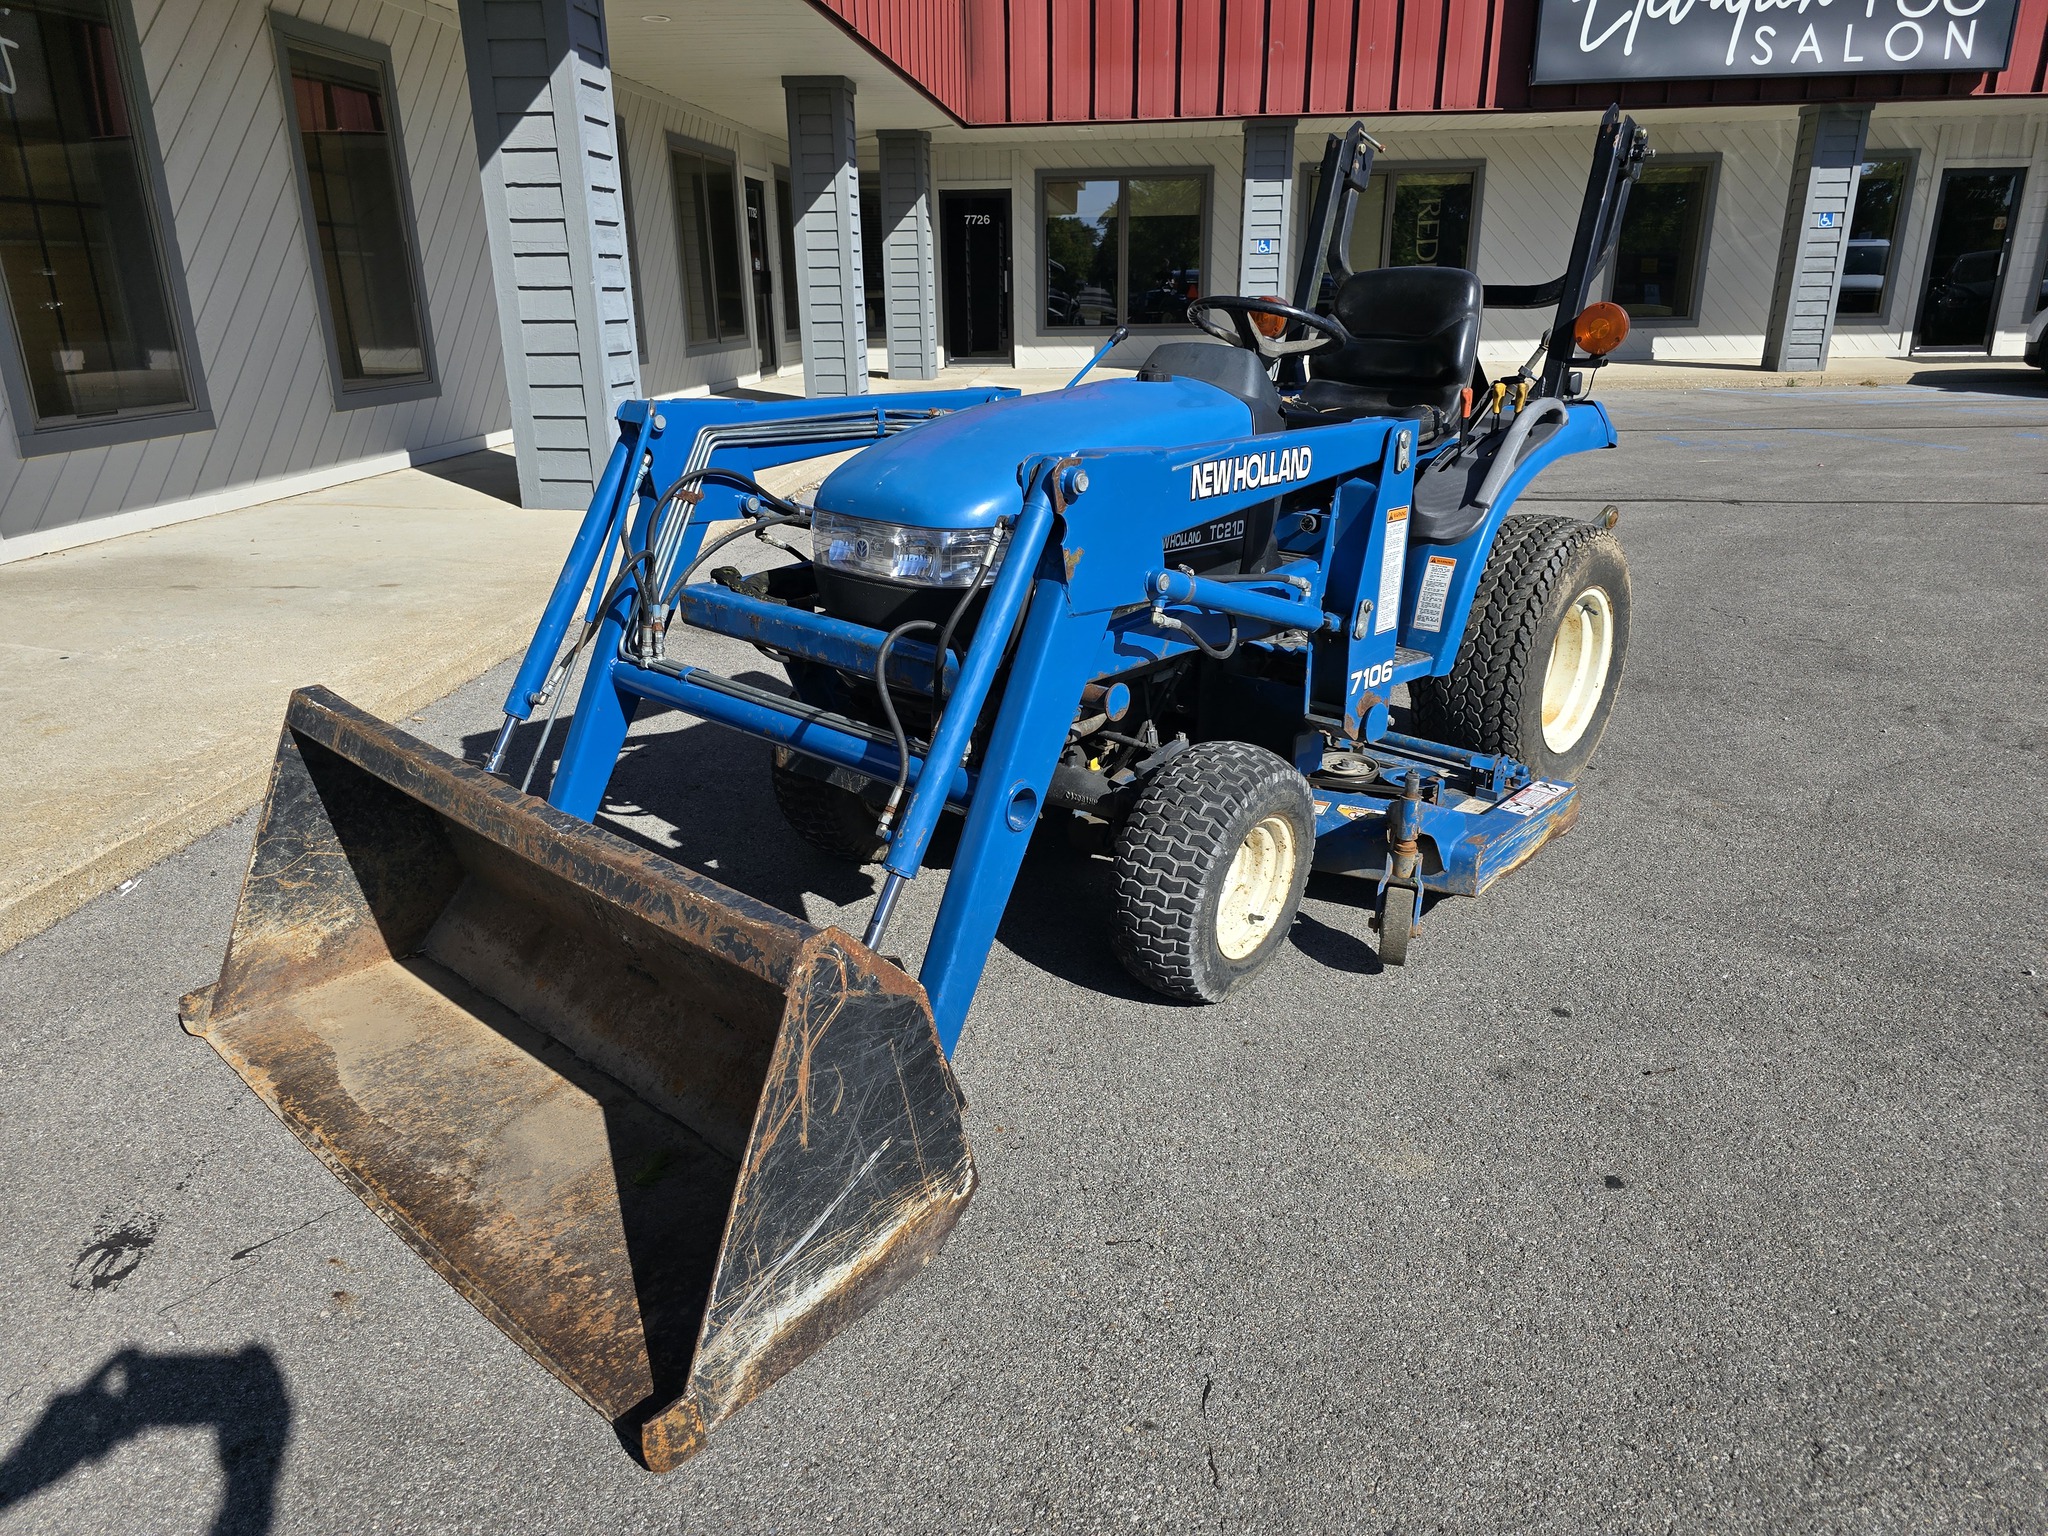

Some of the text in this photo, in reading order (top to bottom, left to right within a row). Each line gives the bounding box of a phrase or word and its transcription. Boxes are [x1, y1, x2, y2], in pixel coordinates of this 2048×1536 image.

[1750, 19, 1977, 66] SALON
[964, 214, 991, 225] 7726
[1415, 198, 1442, 266] RED
[1190, 446, 1313, 501] NEW HOLLAND
[1169, 530, 1202, 548] HOLLAND
[1210, 519, 1244, 541] TC21D
[1350, 659, 1394, 696] 7106
